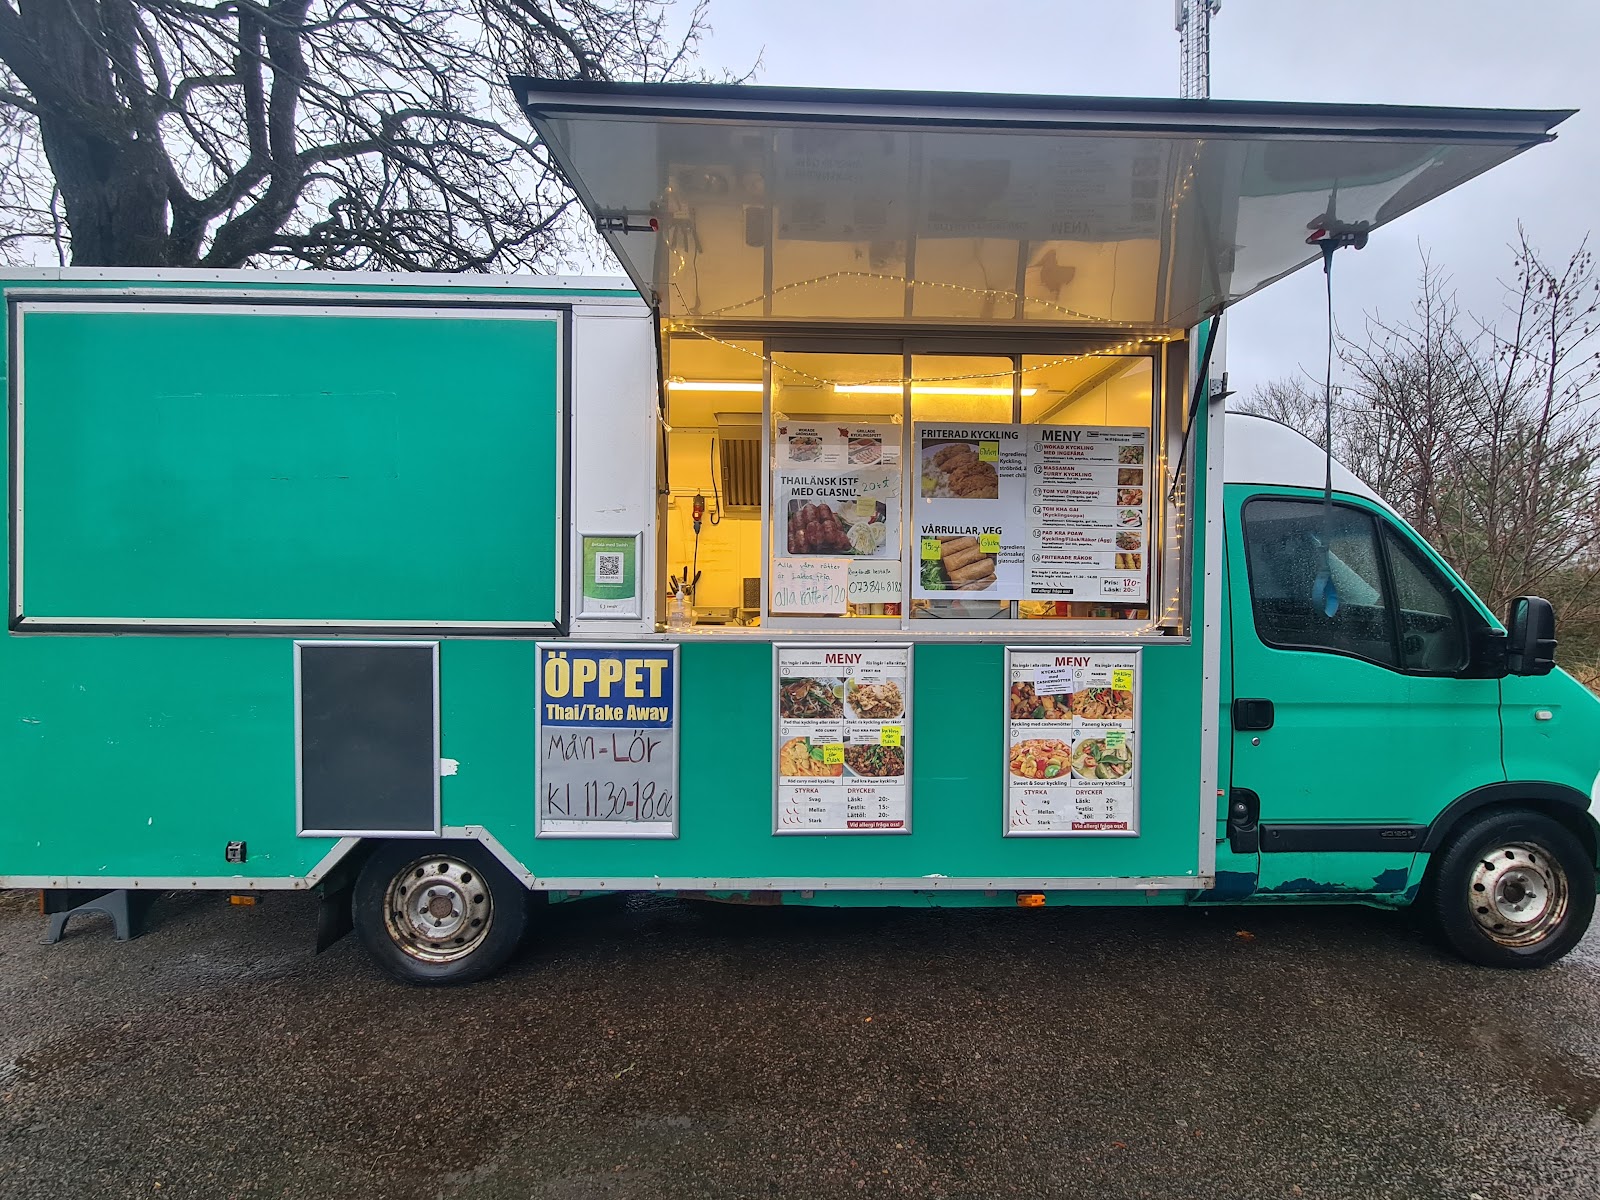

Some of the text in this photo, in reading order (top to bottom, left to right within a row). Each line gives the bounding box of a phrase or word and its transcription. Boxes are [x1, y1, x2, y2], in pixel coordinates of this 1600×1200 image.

[921, 429, 1019, 440] FRITERAD KYCKLING
[1041, 430, 1081, 442] MENY
[780, 475, 837, 486] THAILÄNSK
[791, 487, 861, 498] MED GLASNU
[921, 523, 1002, 535] VÅRRULLAR, VEG
[775, 587, 797, 606] alla
[800, 587, 828, 606] rätter
[825, 653, 862, 665] MENY
[1055, 656, 1091, 668] MENY
[544, 651, 669, 699] ÖPPET
[545, 704, 669, 723] Thai/Take Away
